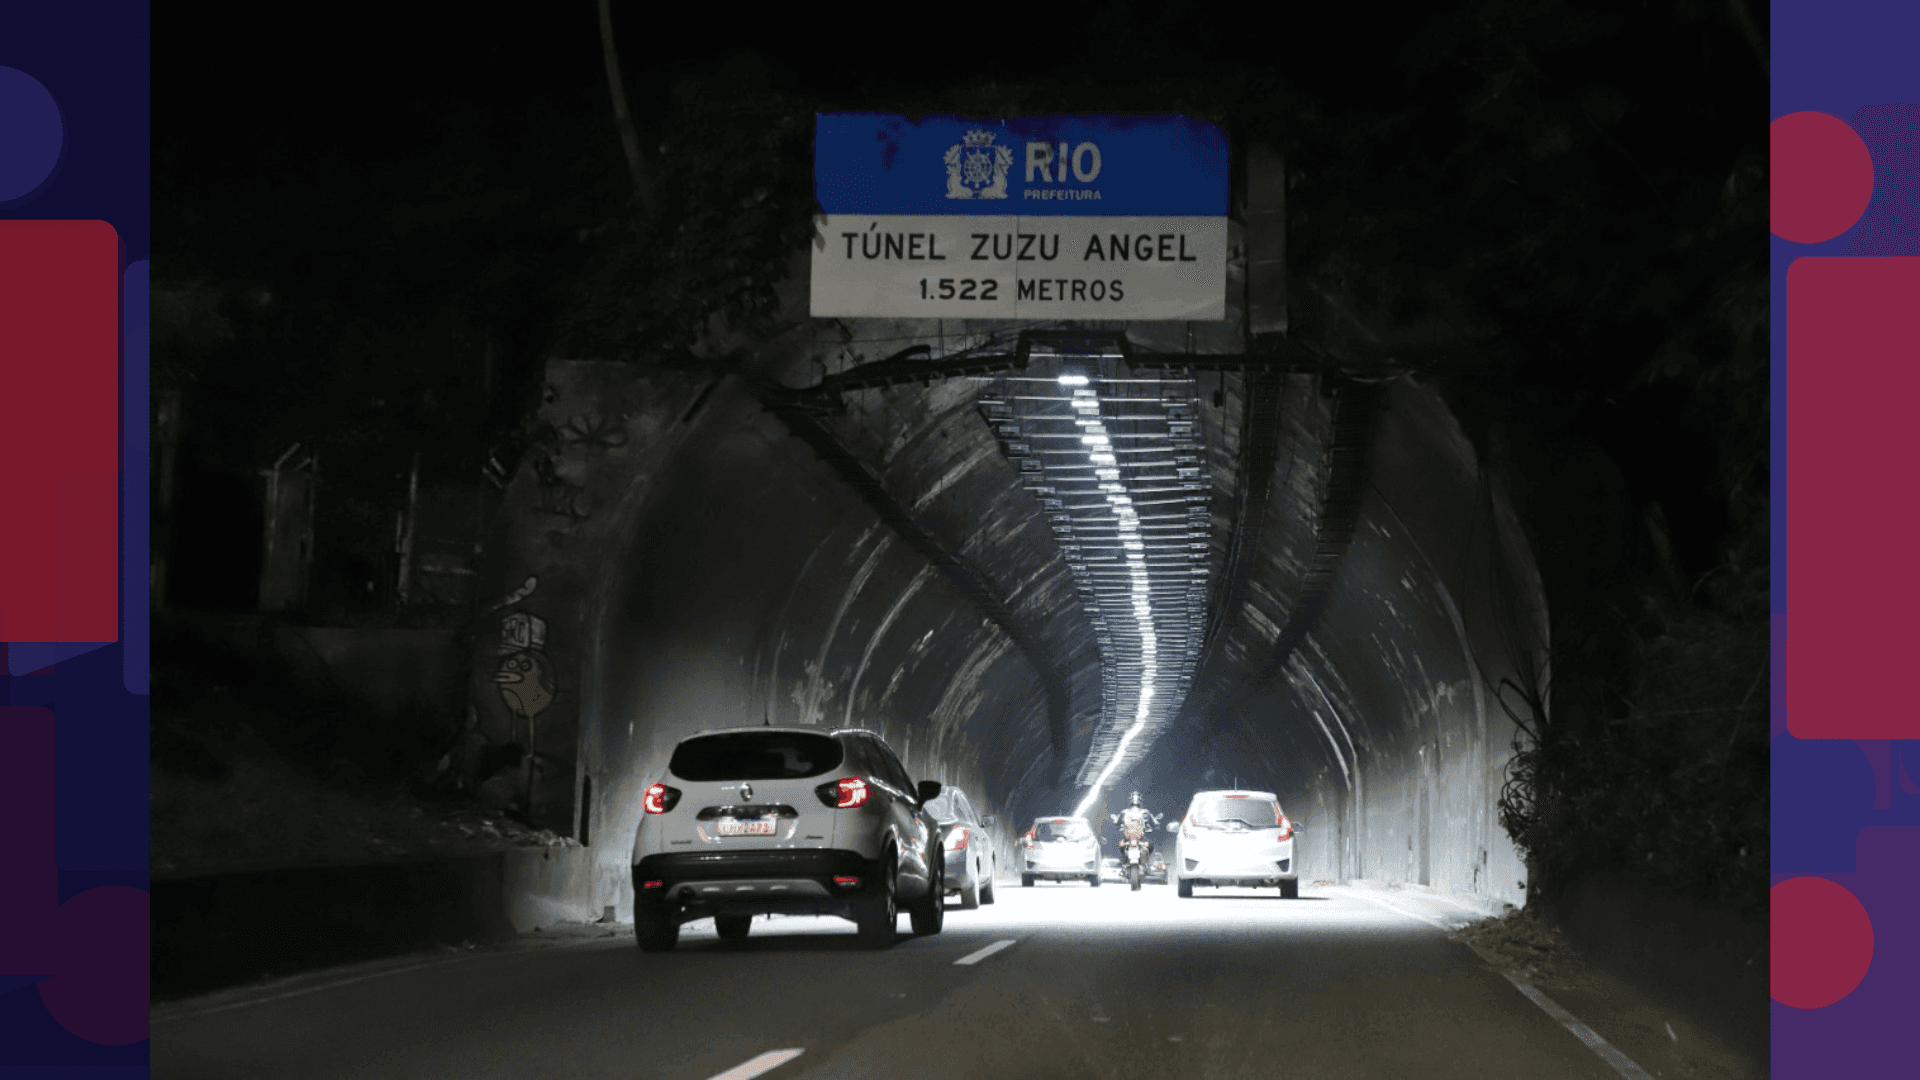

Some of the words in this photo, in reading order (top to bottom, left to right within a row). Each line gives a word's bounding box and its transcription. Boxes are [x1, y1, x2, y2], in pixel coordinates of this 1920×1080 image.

[1024, 142, 1102, 183] RIO
[1023, 190, 1102, 201] PREFEITURA
[841, 221, 946, 260] TÚNEL
[970, 233, 1059, 261] ZUZU
[1083, 234, 1197, 262] ANGEL
[919, 278, 998, 301] 1.522
[1017, 278, 1124, 302] METROS
